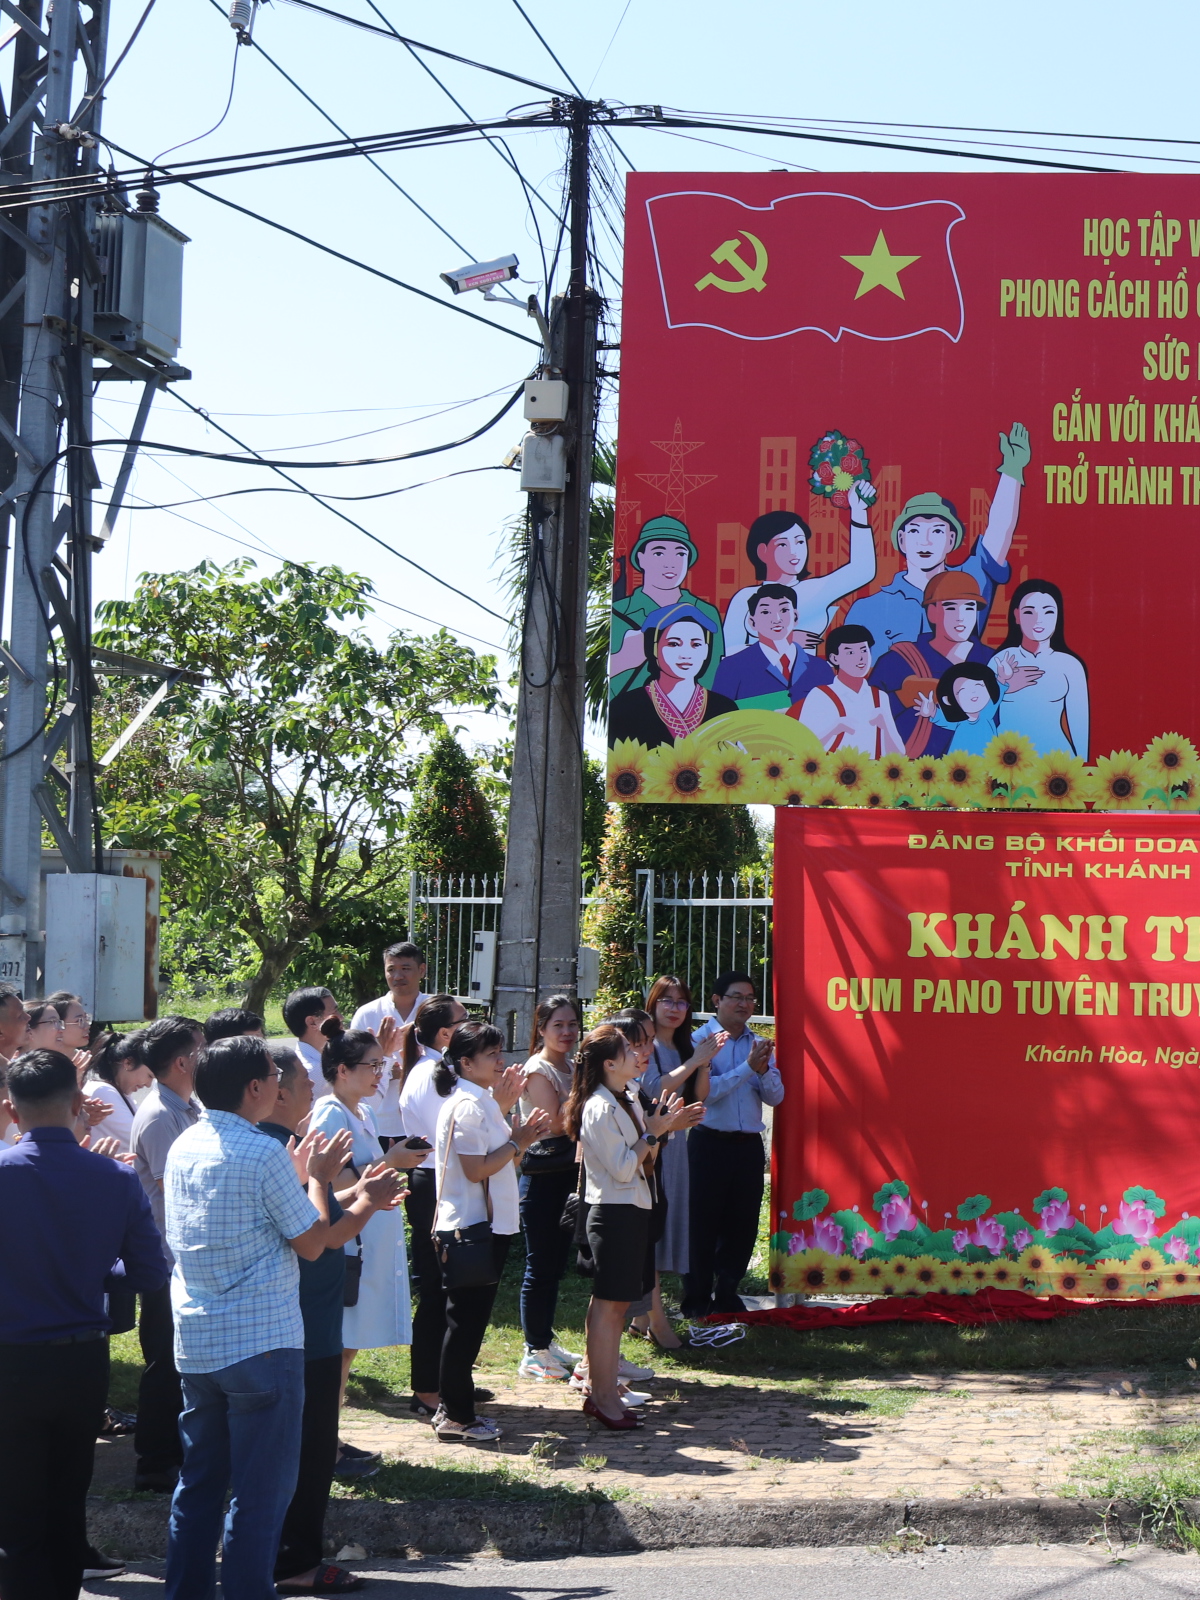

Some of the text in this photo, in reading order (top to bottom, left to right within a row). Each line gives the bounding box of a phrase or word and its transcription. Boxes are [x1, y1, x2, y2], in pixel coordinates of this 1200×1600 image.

[1083, 217, 1131, 266] HỌC
[1137, 210, 1182, 266] TẬP
[1000, 278, 1080, 318] PHONG
[1087, 271, 1150, 319] CÁCH
[1157, 266, 1189, 320] HỒ
[1142, 333, 1190, 381] SỨC
[1052, 387, 1101, 442] GẮN
[1108, 394, 1146, 443] VỚI
[1043, 451, 1089, 505] TRỞ
[1095, 457, 1173, 505] THÀNH
[907, 829, 995, 851] ĐẢNG
[1005, 831, 1046, 855] BỘ
[1056, 828, 1125, 853] KHỐI
[1005, 856, 1073, 878] TỈNH
[1084, 858, 1191, 880] KHÁNH
[907, 900, 1129, 962] KHÁNH
[826, 976, 902, 1020] CỤM
[913, 978, 1002, 1015] PANO
[1012, 973, 1119, 1016] TUYÊN
[1025, 1044, 1093, 1063] Khánh
[1099, 1045, 1148, 1067] Hòa,
